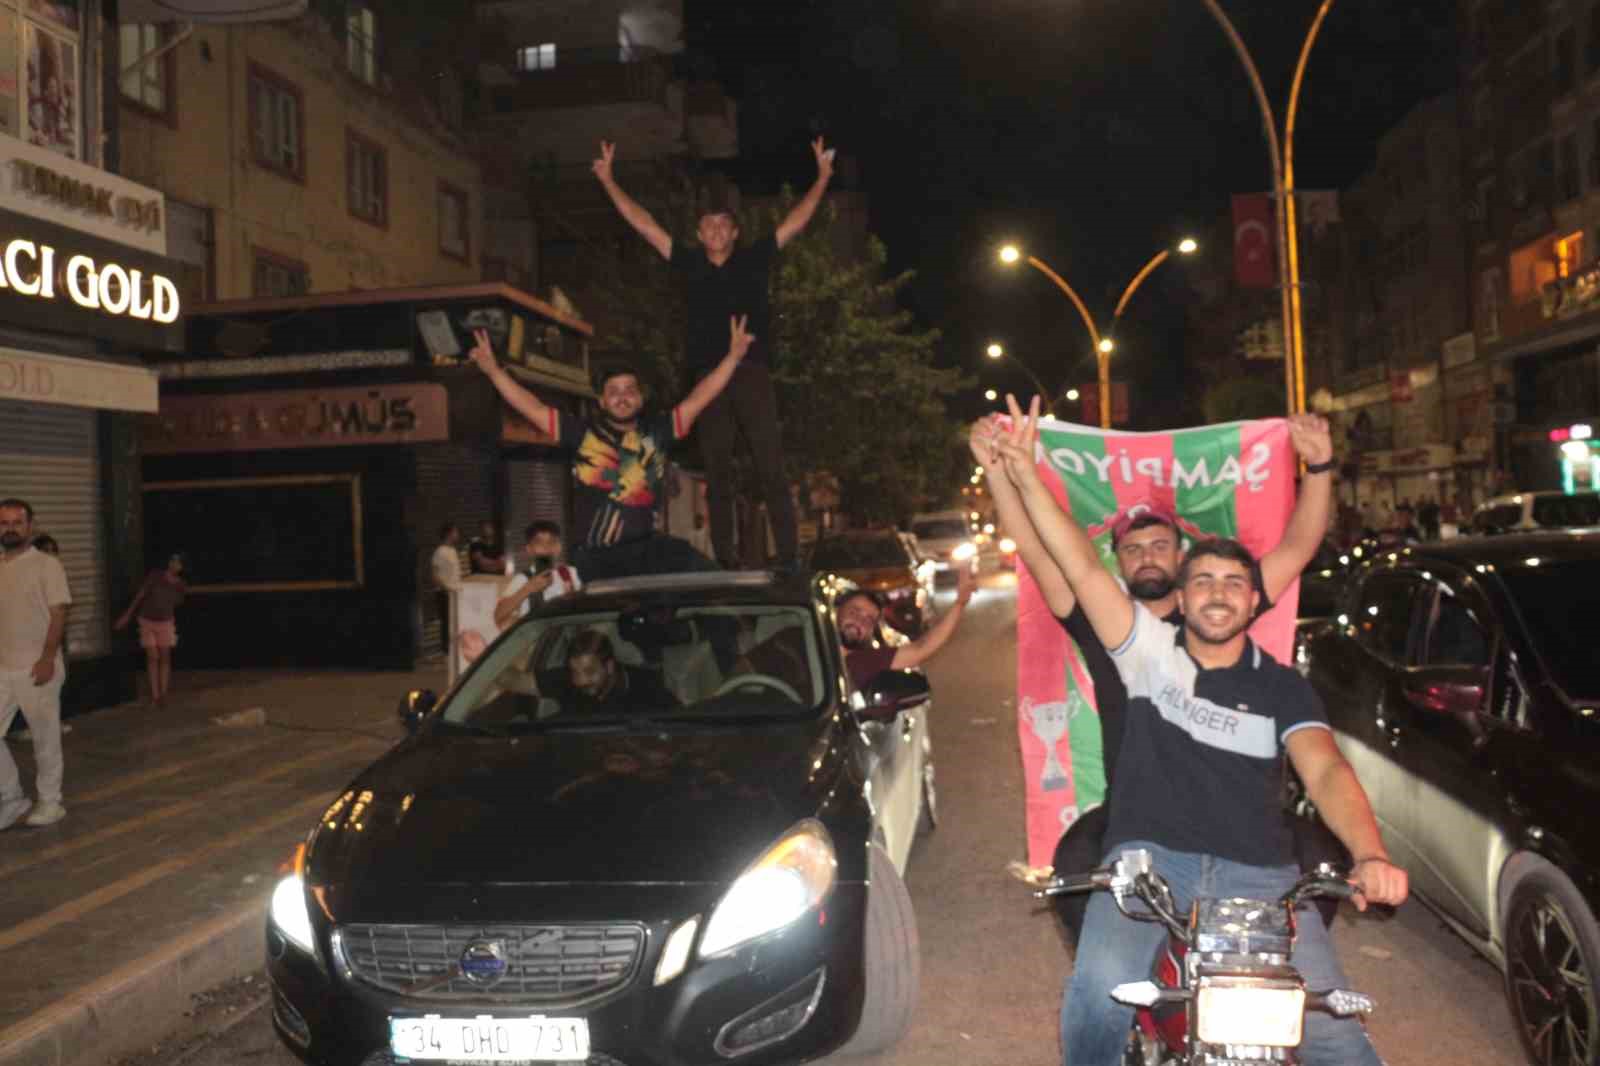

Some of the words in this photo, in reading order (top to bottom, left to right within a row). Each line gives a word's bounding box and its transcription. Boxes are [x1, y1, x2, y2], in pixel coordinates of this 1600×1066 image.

[0, 239, 54, 298] CI
[67, 255, 180, 323] GOLD
[411, 1025, 441, 1053] 34
[533, 1024, 578, 1053] 731
